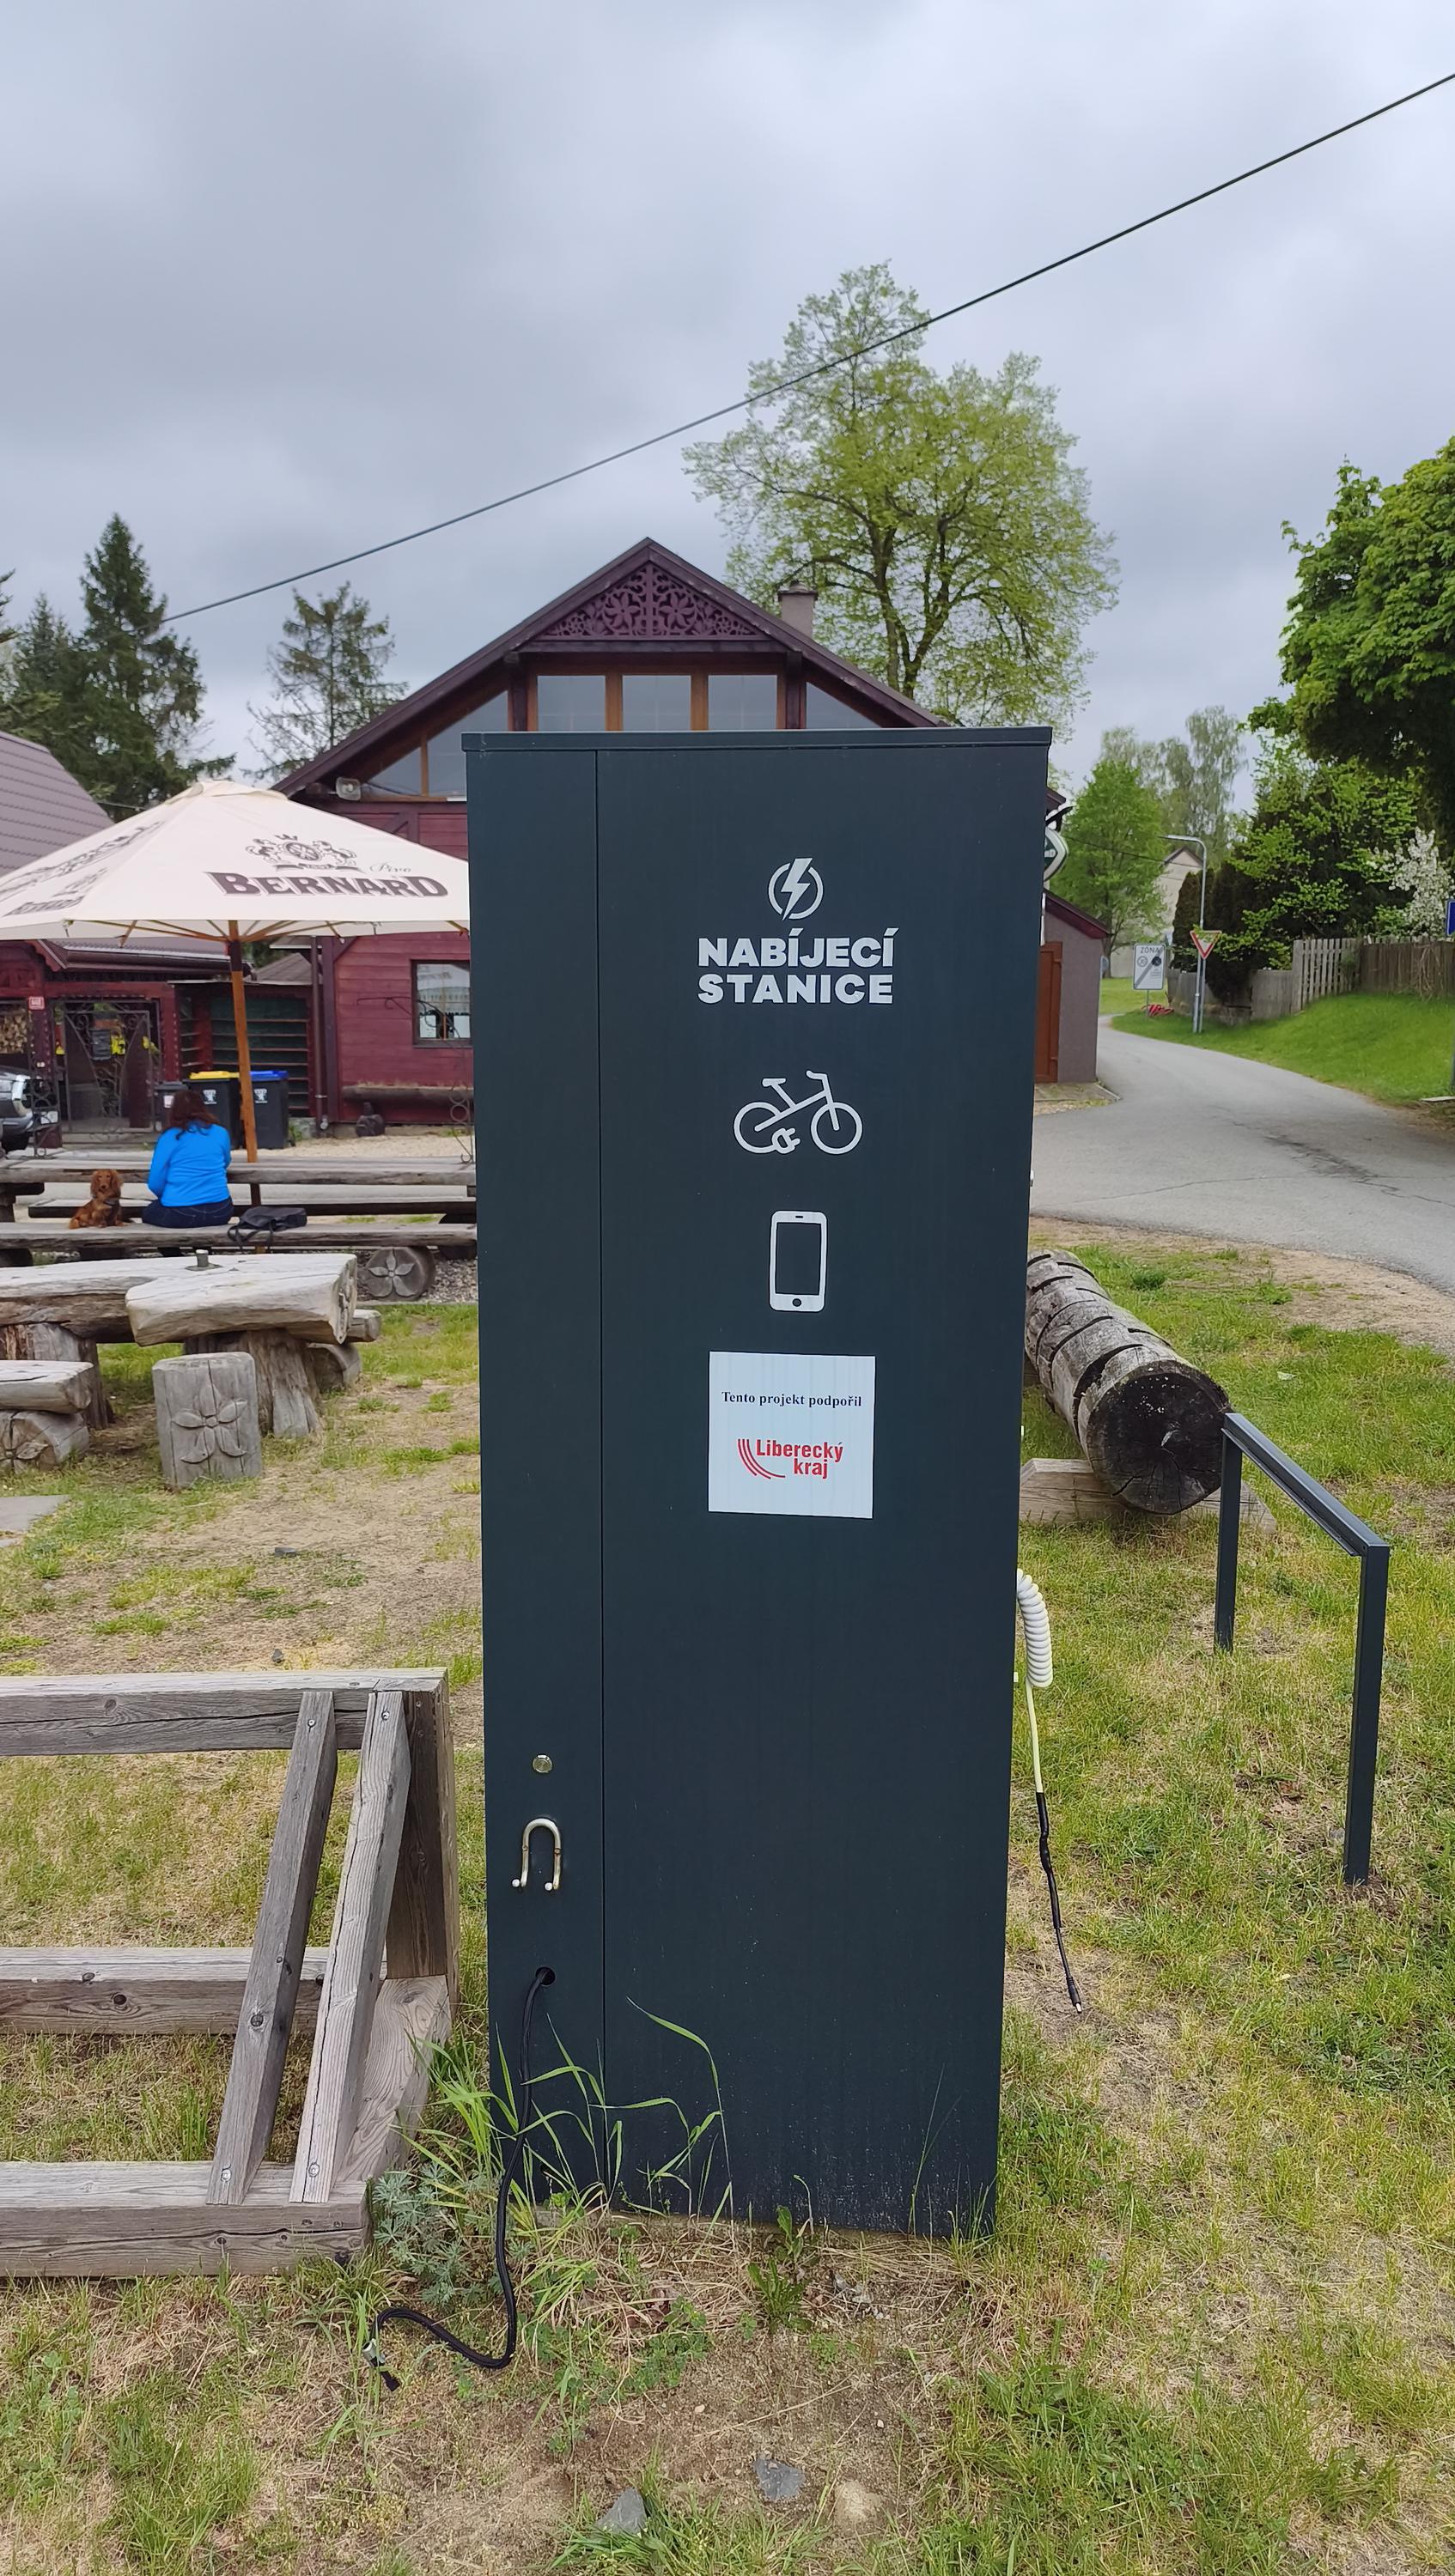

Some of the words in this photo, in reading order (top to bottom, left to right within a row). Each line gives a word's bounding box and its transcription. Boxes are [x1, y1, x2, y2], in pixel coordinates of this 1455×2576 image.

[204, 872, 448, 897] BERNARD
[697, 927, 899, 968] NABÍJECÍ
[697, 974, 893, 1004] STANICE
[721, 1391, 756, 1403] Tento
[759, 1394, 805, 1407] projekt
[808, 1395, 862, 1408] podpořil
[756, 1439, 843, 1462] Liberecký
[794, 1458, 828, 1479] kraj
